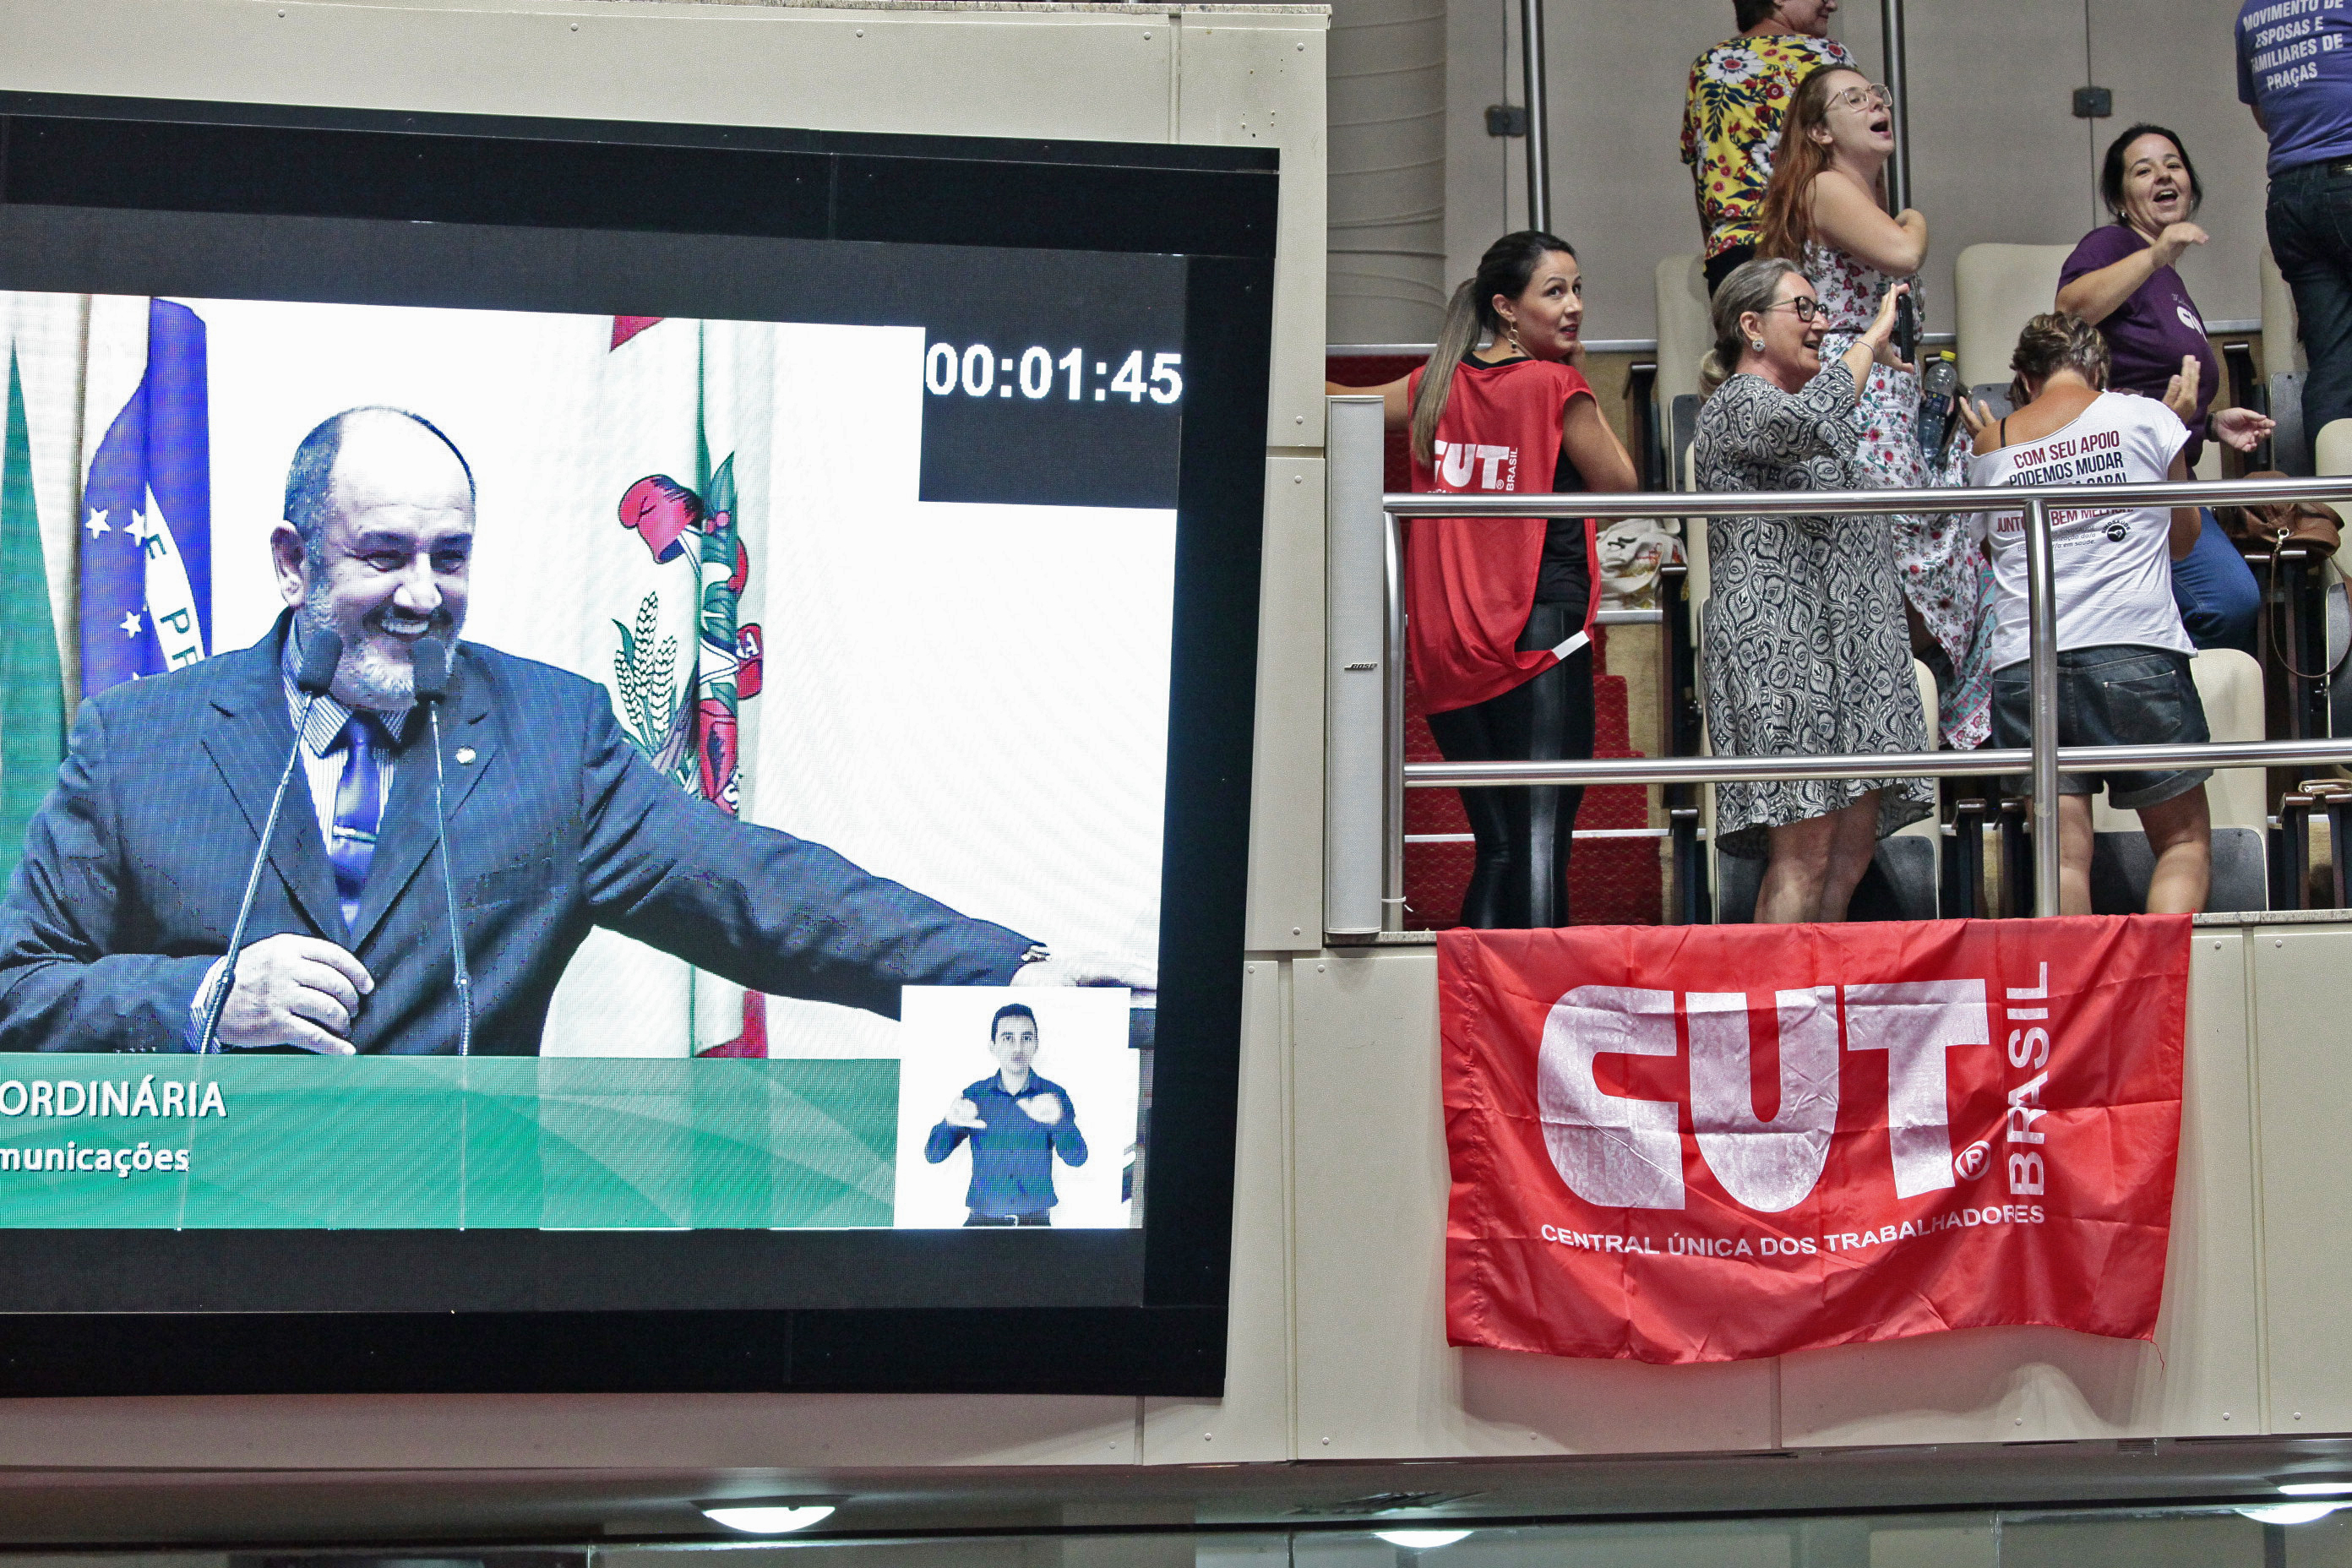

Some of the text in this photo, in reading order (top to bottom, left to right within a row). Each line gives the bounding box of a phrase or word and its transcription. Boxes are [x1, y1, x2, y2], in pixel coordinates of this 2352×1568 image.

[2243, 0, 2344, 32] MOVIMENTO DE
[2255, 16, 2324, 49] ESPOSAS E
[2322, 33, 2344, 52] DE
[2266, 62, 2318, 91] PRAÇAS
[926, 342, 1184, 404] 00:01:45
[2009, 461, 2073, 487] PODEMOS
[2075, 451, 2124, 476] MUDAR
[2013, 430, 2121, 469] COM SEU APOIO
[1505, 447, 1519, 492] BRASIL
[2050, 509, 2078, 526] BEM
[0, 1074, 227, 1118] ORDINÁRIA
[1538, 978, 1990, 1212] CUT
[2006, 961, 2050, 1195] BRASIL
[1541, 1205, 2046, 1257] CENTRAL ÚNICA DOS TRABALHADORES
